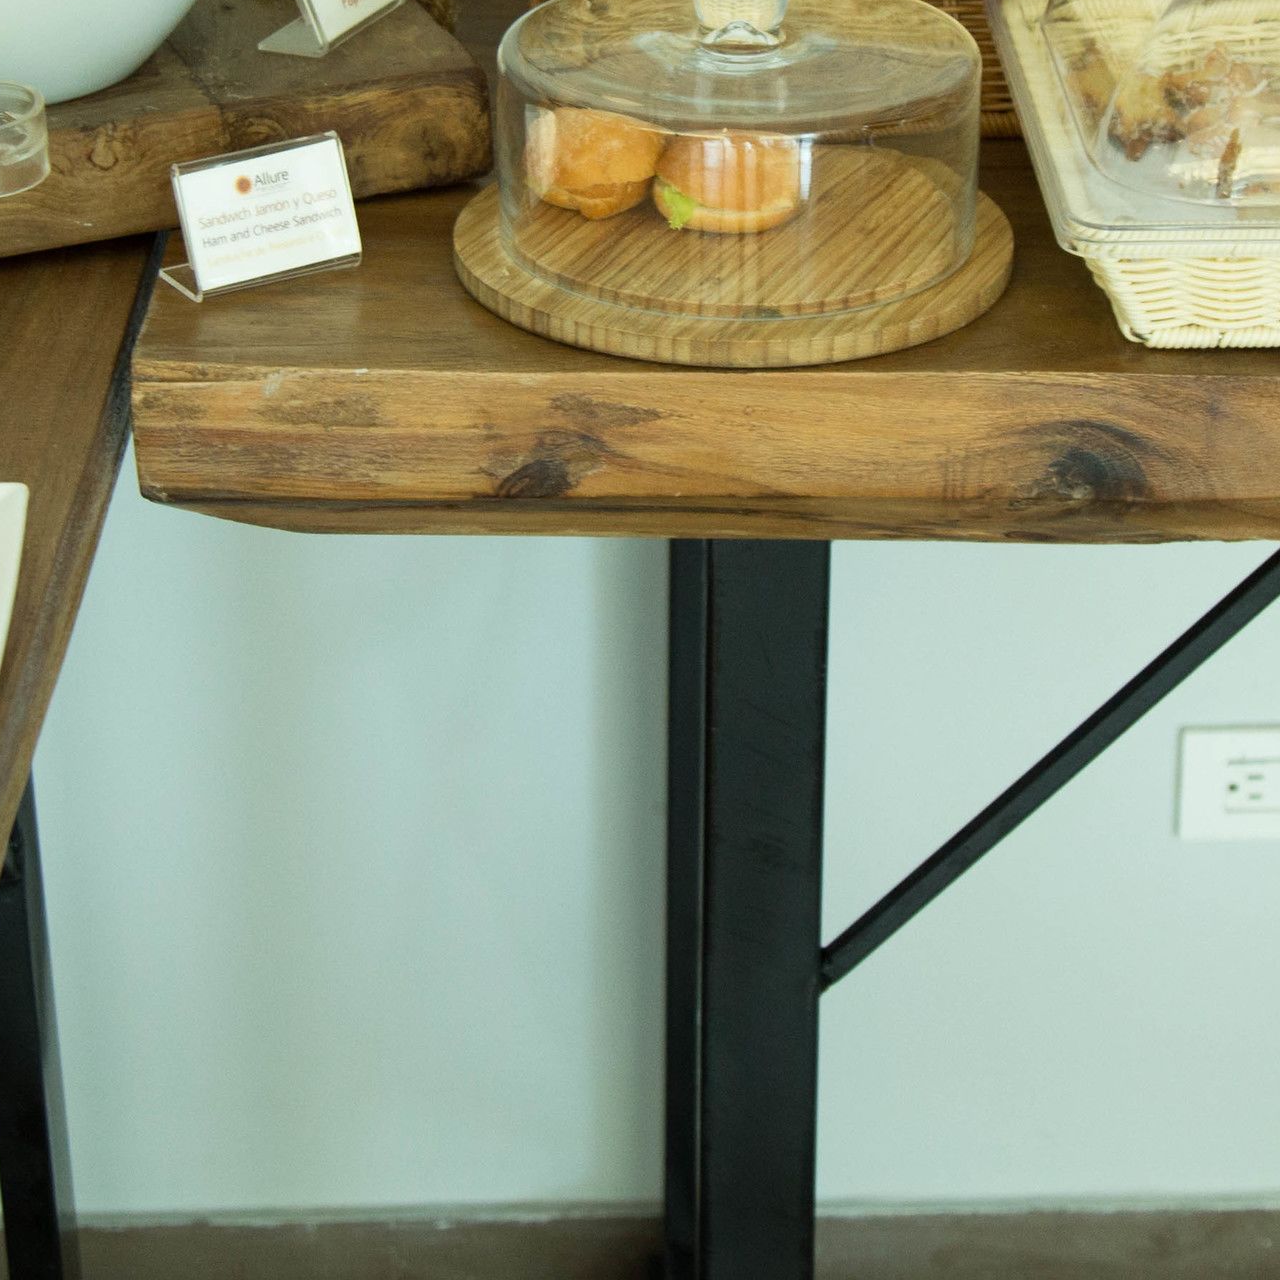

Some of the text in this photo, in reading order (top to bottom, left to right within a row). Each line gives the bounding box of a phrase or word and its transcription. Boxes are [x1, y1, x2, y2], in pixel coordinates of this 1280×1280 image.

[254, 169, 289, 187] Allure
[198, 206, 252, 230] Sandwich
[302, 188, 338, 206] Queso
[202, 234, 227, 249] Ham
[230, 226, 250, 243] and
[253, 219, 291, 237] Cheese
[292, 206, 342, 228] Sandwich
